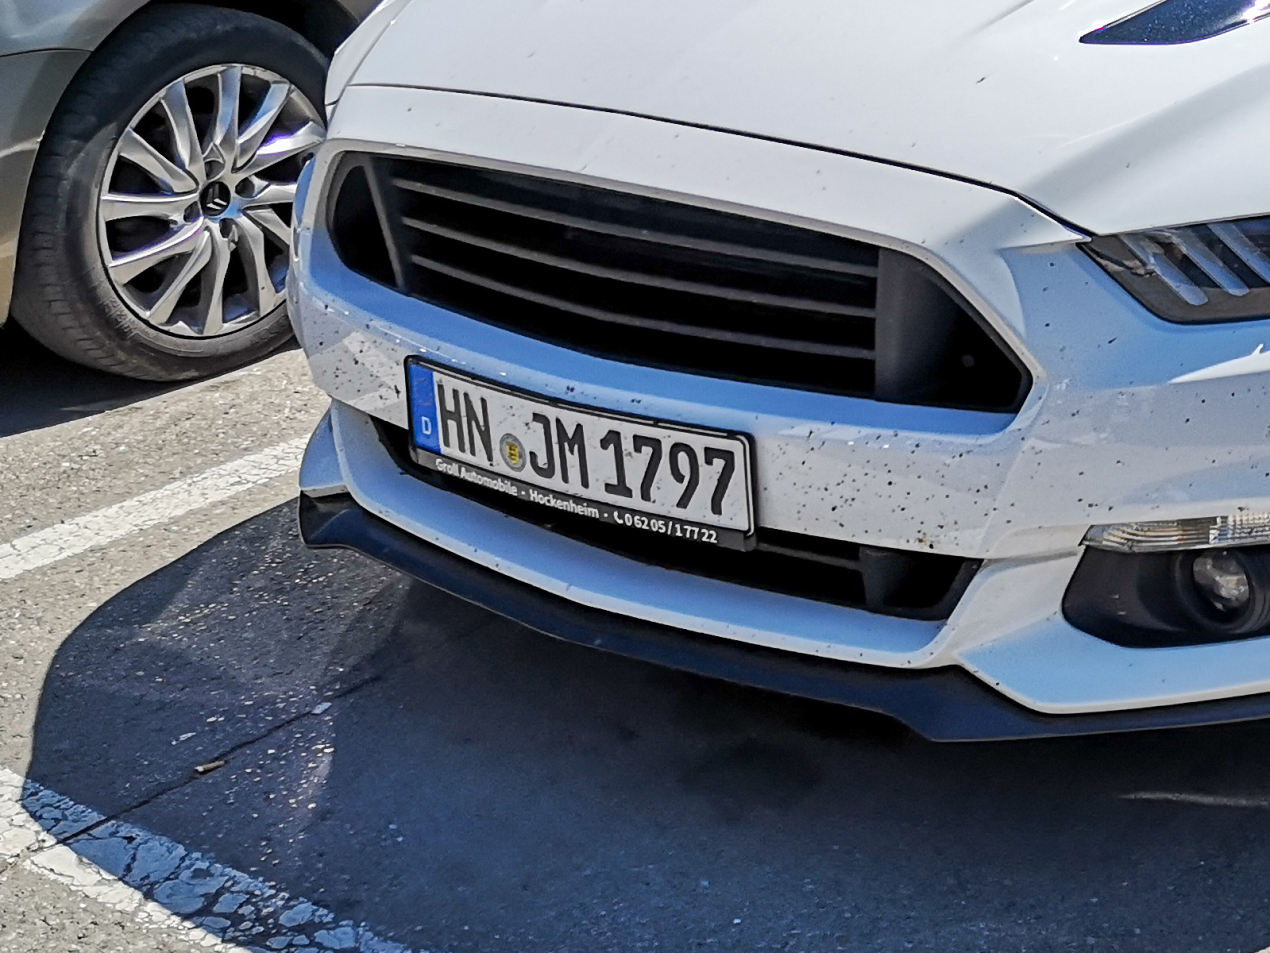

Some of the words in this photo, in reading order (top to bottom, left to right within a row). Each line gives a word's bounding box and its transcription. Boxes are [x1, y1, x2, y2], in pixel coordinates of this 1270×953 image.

[421, 416, 432, 435] D
[437, 383, 493, 463] HN
[529, 412, 589, 489] JM
[600, 430, 735, 516] 1797
[460, 467, 518, 496] Automobile
[530, 489, 599, 519] Hockenheim
